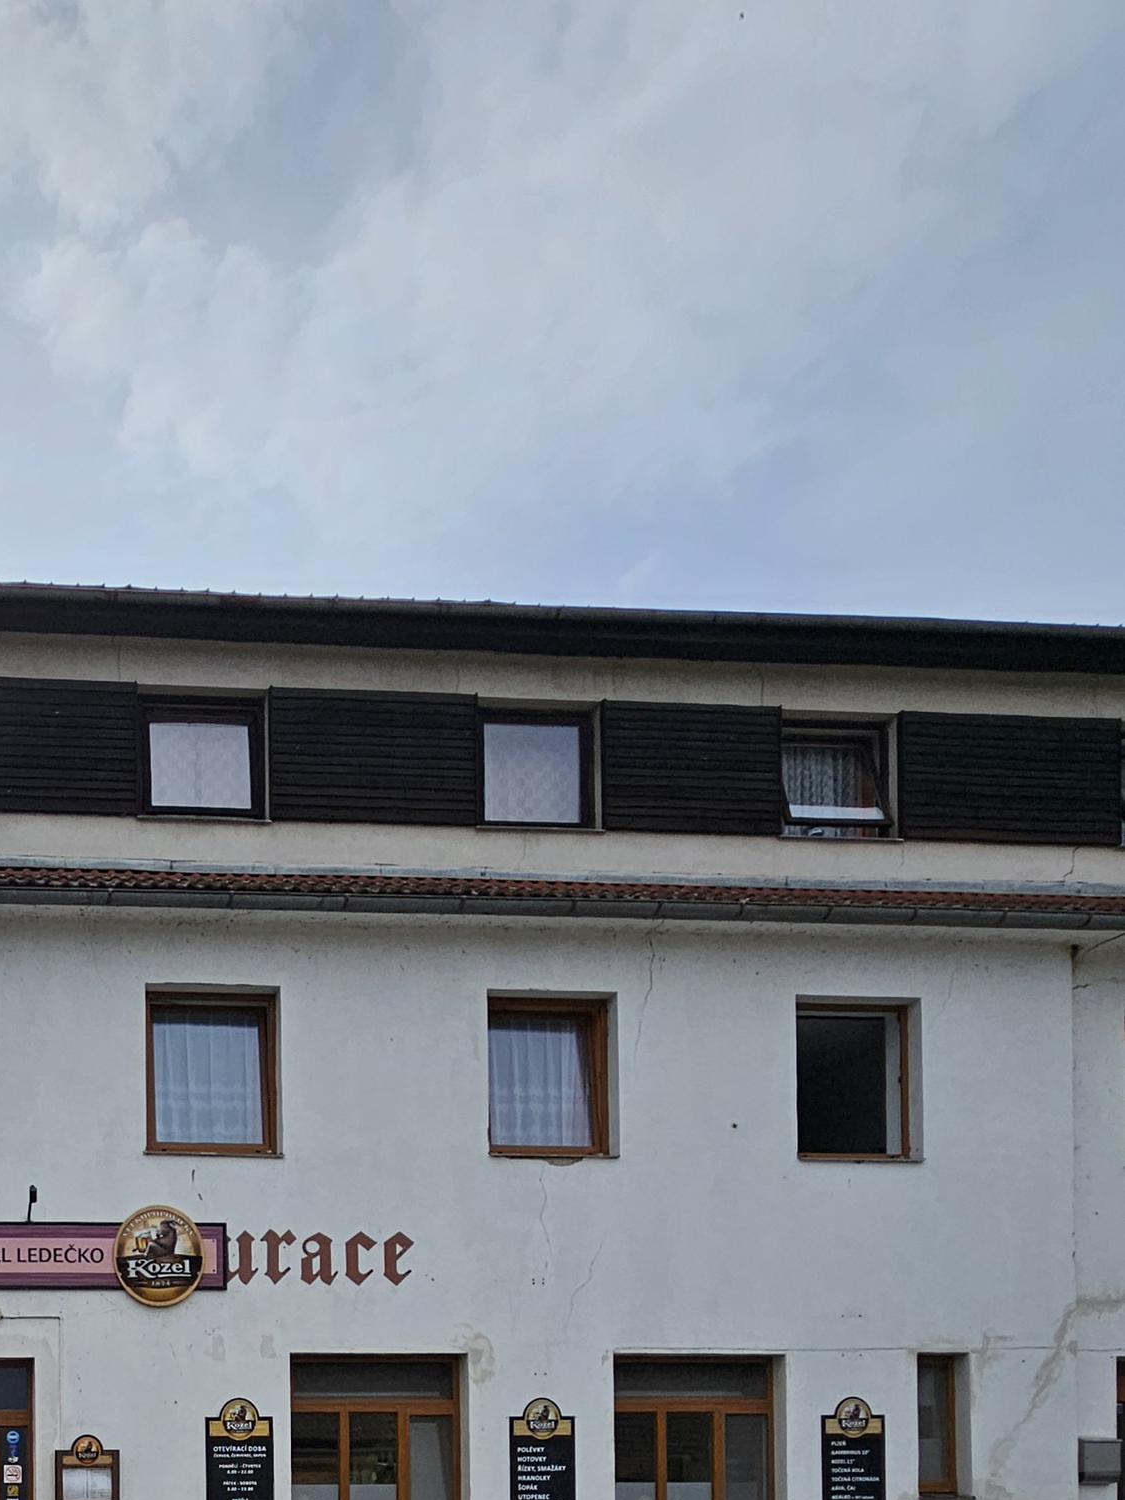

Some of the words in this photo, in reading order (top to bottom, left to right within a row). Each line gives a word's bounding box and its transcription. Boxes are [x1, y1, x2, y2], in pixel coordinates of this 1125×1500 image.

[17, 1244, 104, 1263] LEDEČKO
[127, 1259, 191, 1279] Kozel
[226, 1421, 252, 1430] Kozel
[530, 1420, 555, 1429] Kozel
